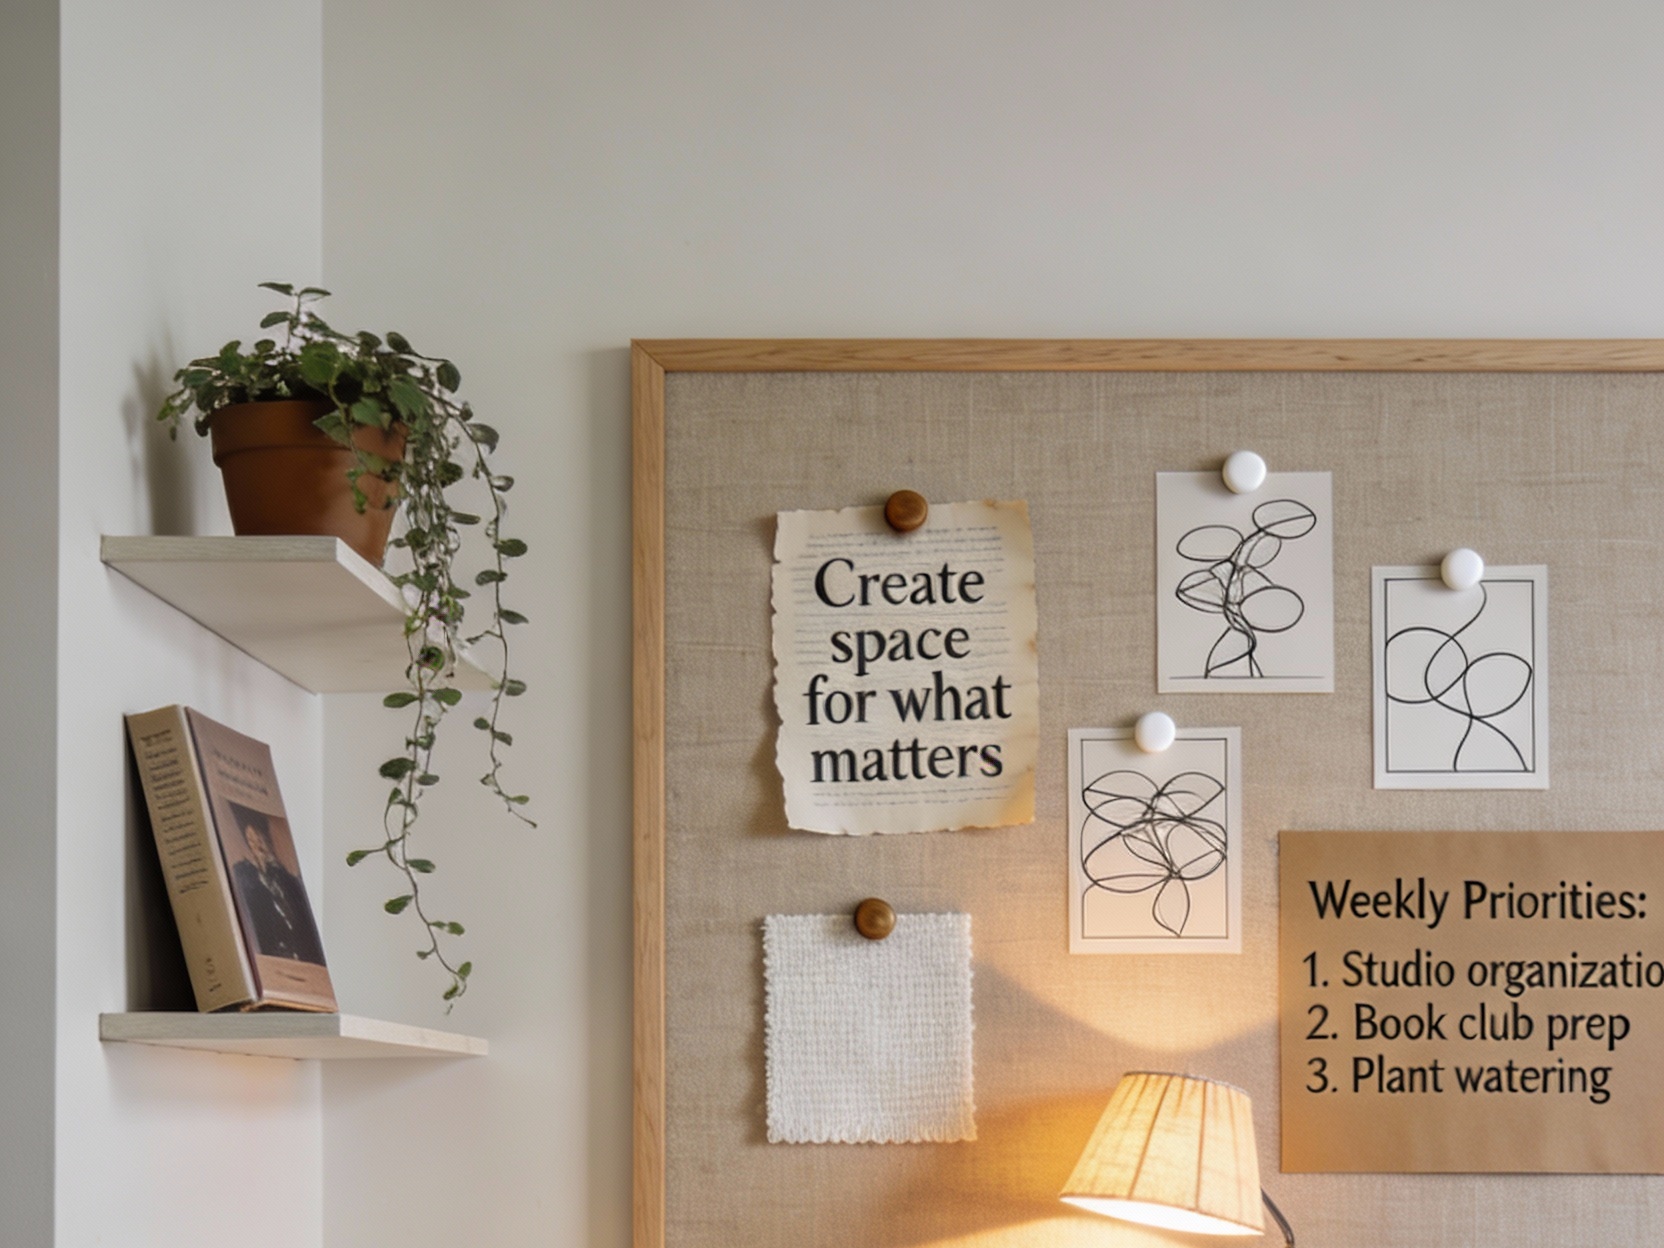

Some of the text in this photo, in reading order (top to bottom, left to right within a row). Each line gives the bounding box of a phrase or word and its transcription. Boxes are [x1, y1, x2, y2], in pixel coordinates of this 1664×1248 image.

[814, 557, 985, 607] Create
[830, 625, 971, 677] space
[803, 670, 1012, 725] for what
[810, 738, 1003, 784] matters
[1308, 877, 1647, 929] Weekly Priorities:
[1302, 949, 1664, 998] 1. Studio organizatio
[1306, 1002, 1630, 1051] 2. Book club prep
[1306, 1055, 1612, 1104] 3. Plant watering
